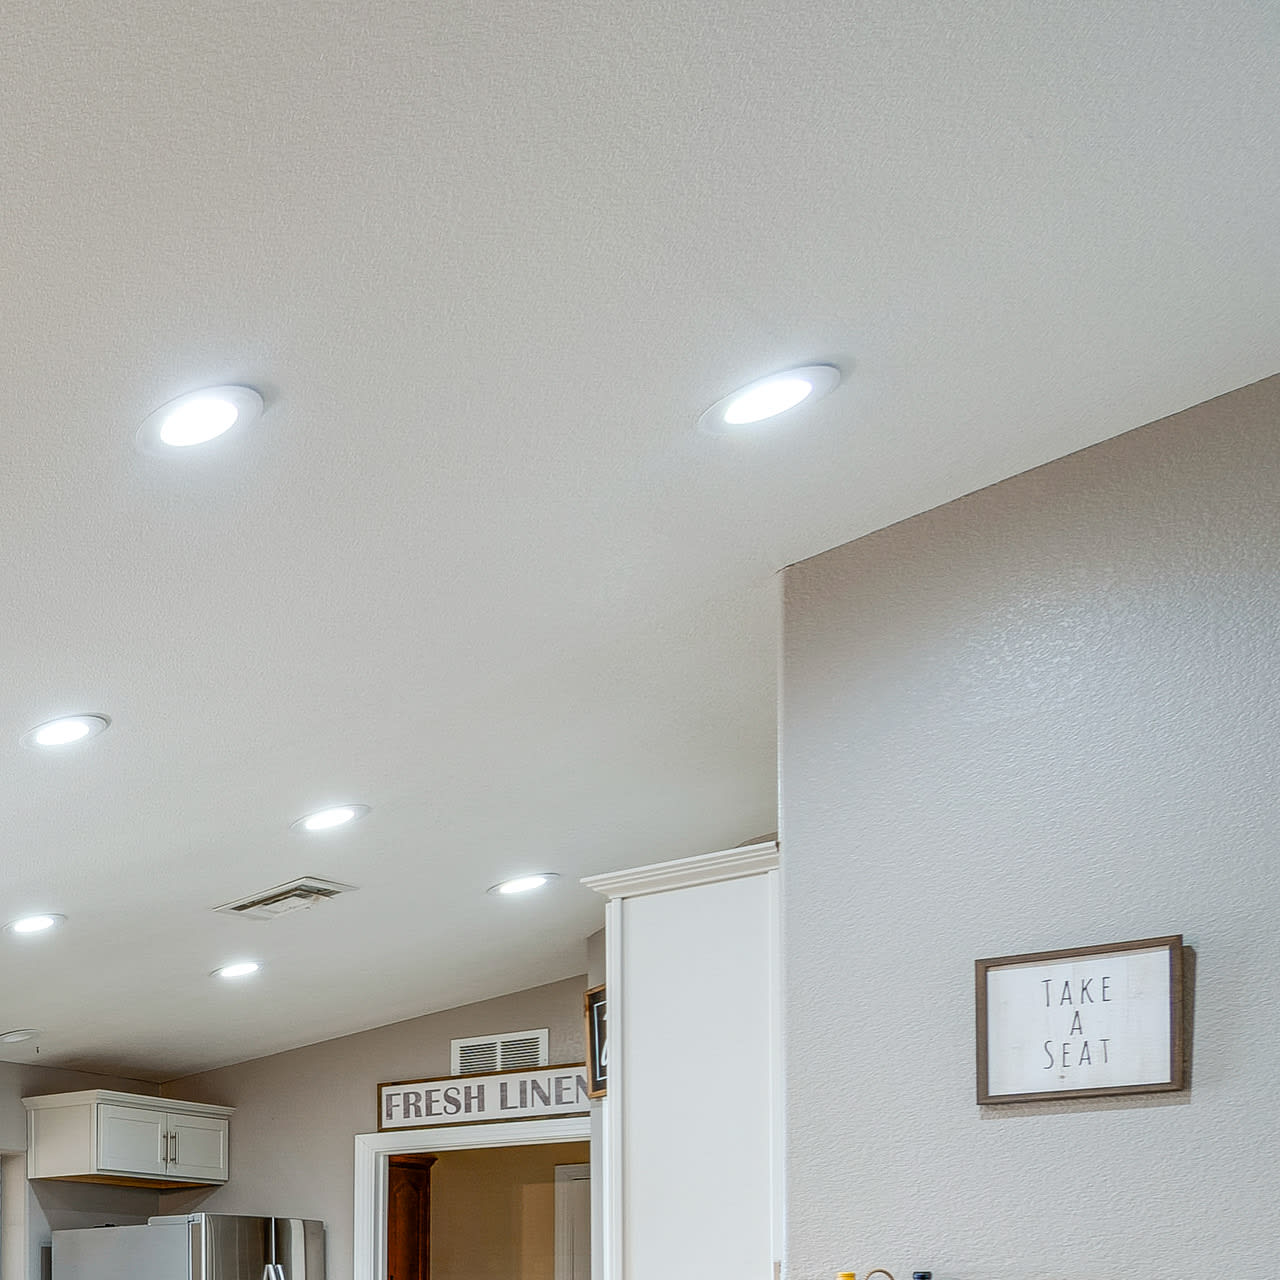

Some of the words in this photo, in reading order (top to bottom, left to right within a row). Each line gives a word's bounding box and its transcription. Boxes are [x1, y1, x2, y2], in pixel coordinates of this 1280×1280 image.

[1041, 976, 1112, 1007] TAKE
[1070, 1010, 1083, 1036] A
[1043, 1038, 1111, 1070] SEAT
[385, 1084, 485, 1121] FRESH
